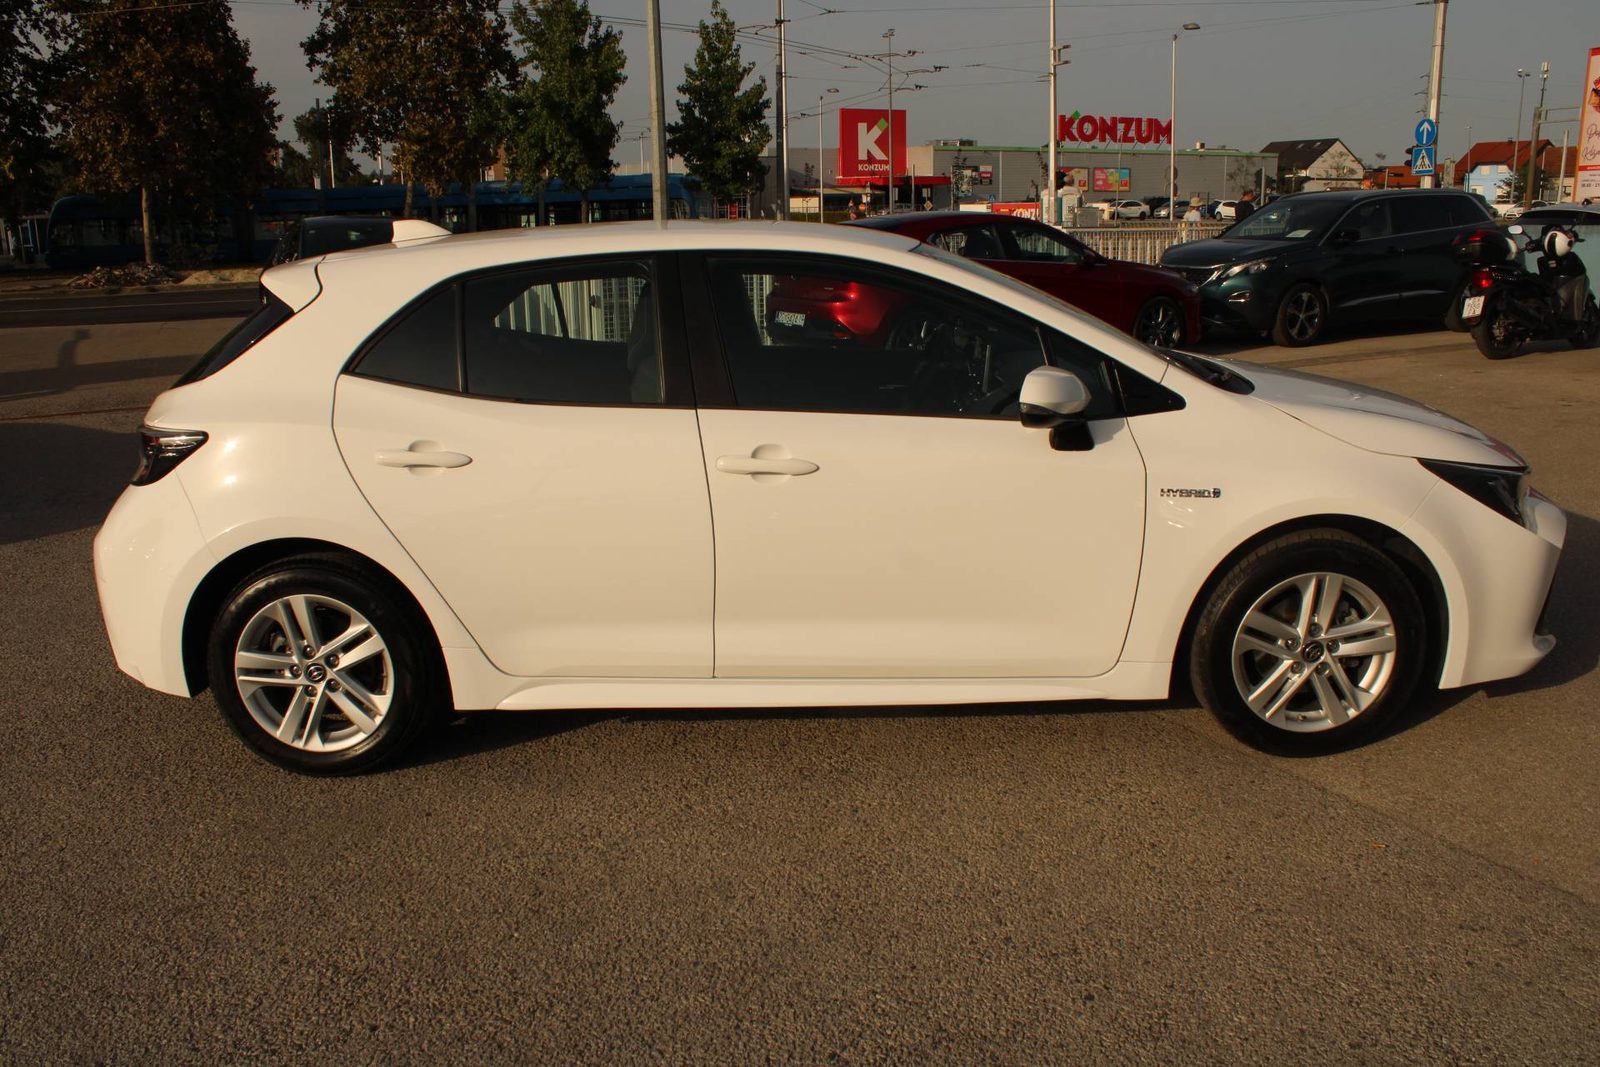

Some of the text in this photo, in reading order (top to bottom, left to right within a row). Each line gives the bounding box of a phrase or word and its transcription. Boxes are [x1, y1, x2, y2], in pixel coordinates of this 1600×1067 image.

[1058, 111, 1172, 144] KONZUM
[857, 117, 888, 161] K
[858, 163, 890, 171] KONZUM
[1160, 488, 1212, 498] HYBRID
